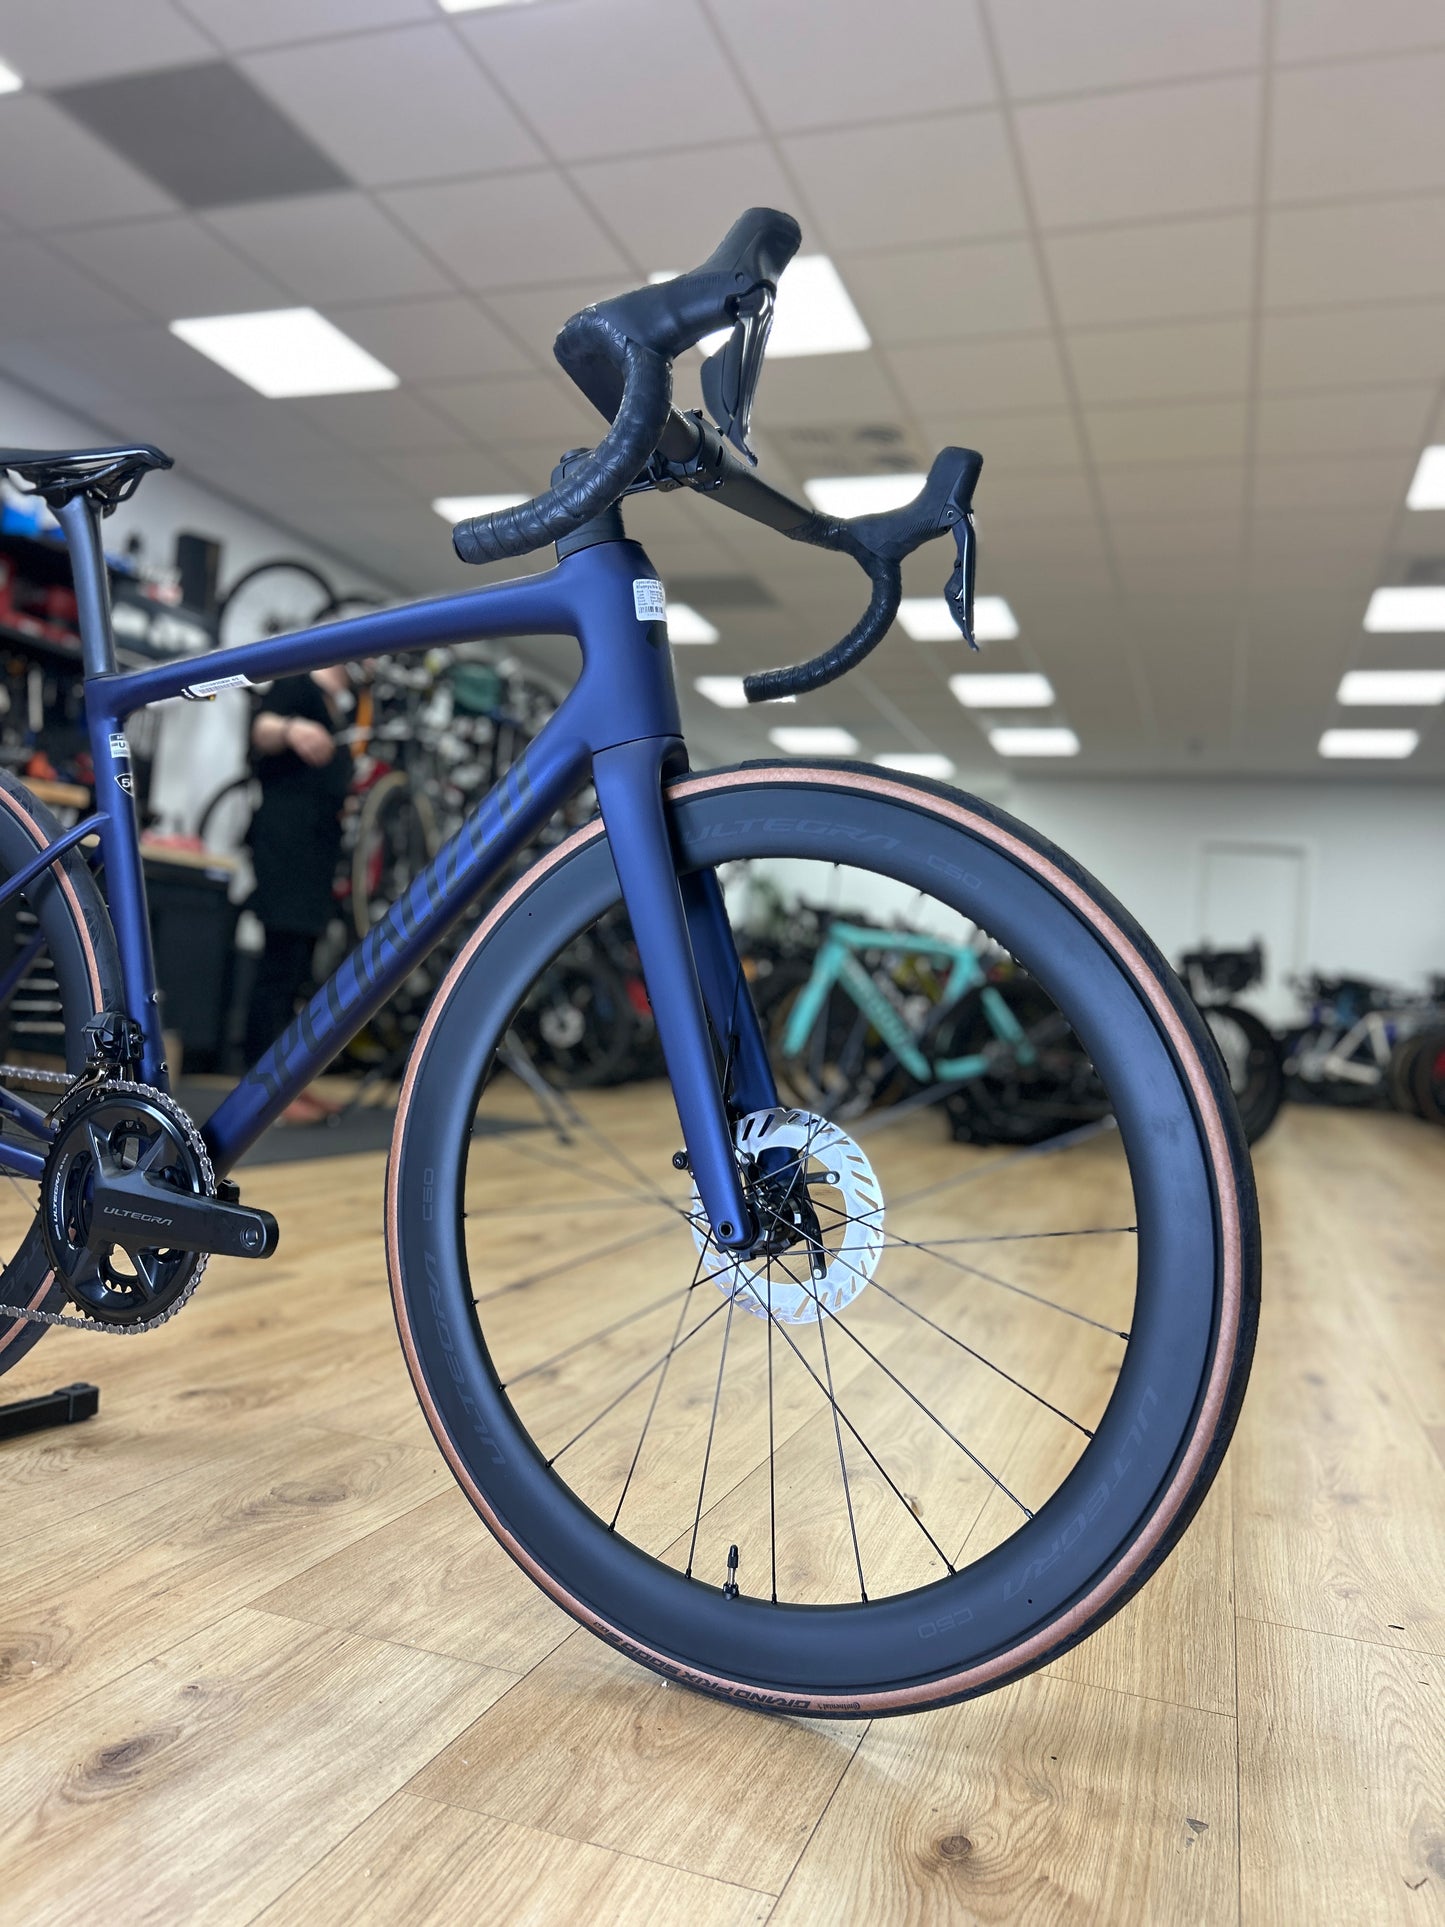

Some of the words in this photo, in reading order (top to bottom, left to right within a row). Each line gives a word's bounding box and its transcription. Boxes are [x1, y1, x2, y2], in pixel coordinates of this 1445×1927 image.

[53, 1171, 61, 1223] ULTEGRA
[103, 1206, 173, 1226] ULTEGRA
[423, 1250, 506, 1465] ULTEGRA
[1003, 1385, 1159, 1601] ULTEGRA
[621, 1641, 682, 1674] 5000
[681, 1671, 734, 1693] PRIX
[733, 1688, 812, 1708] GRAND
